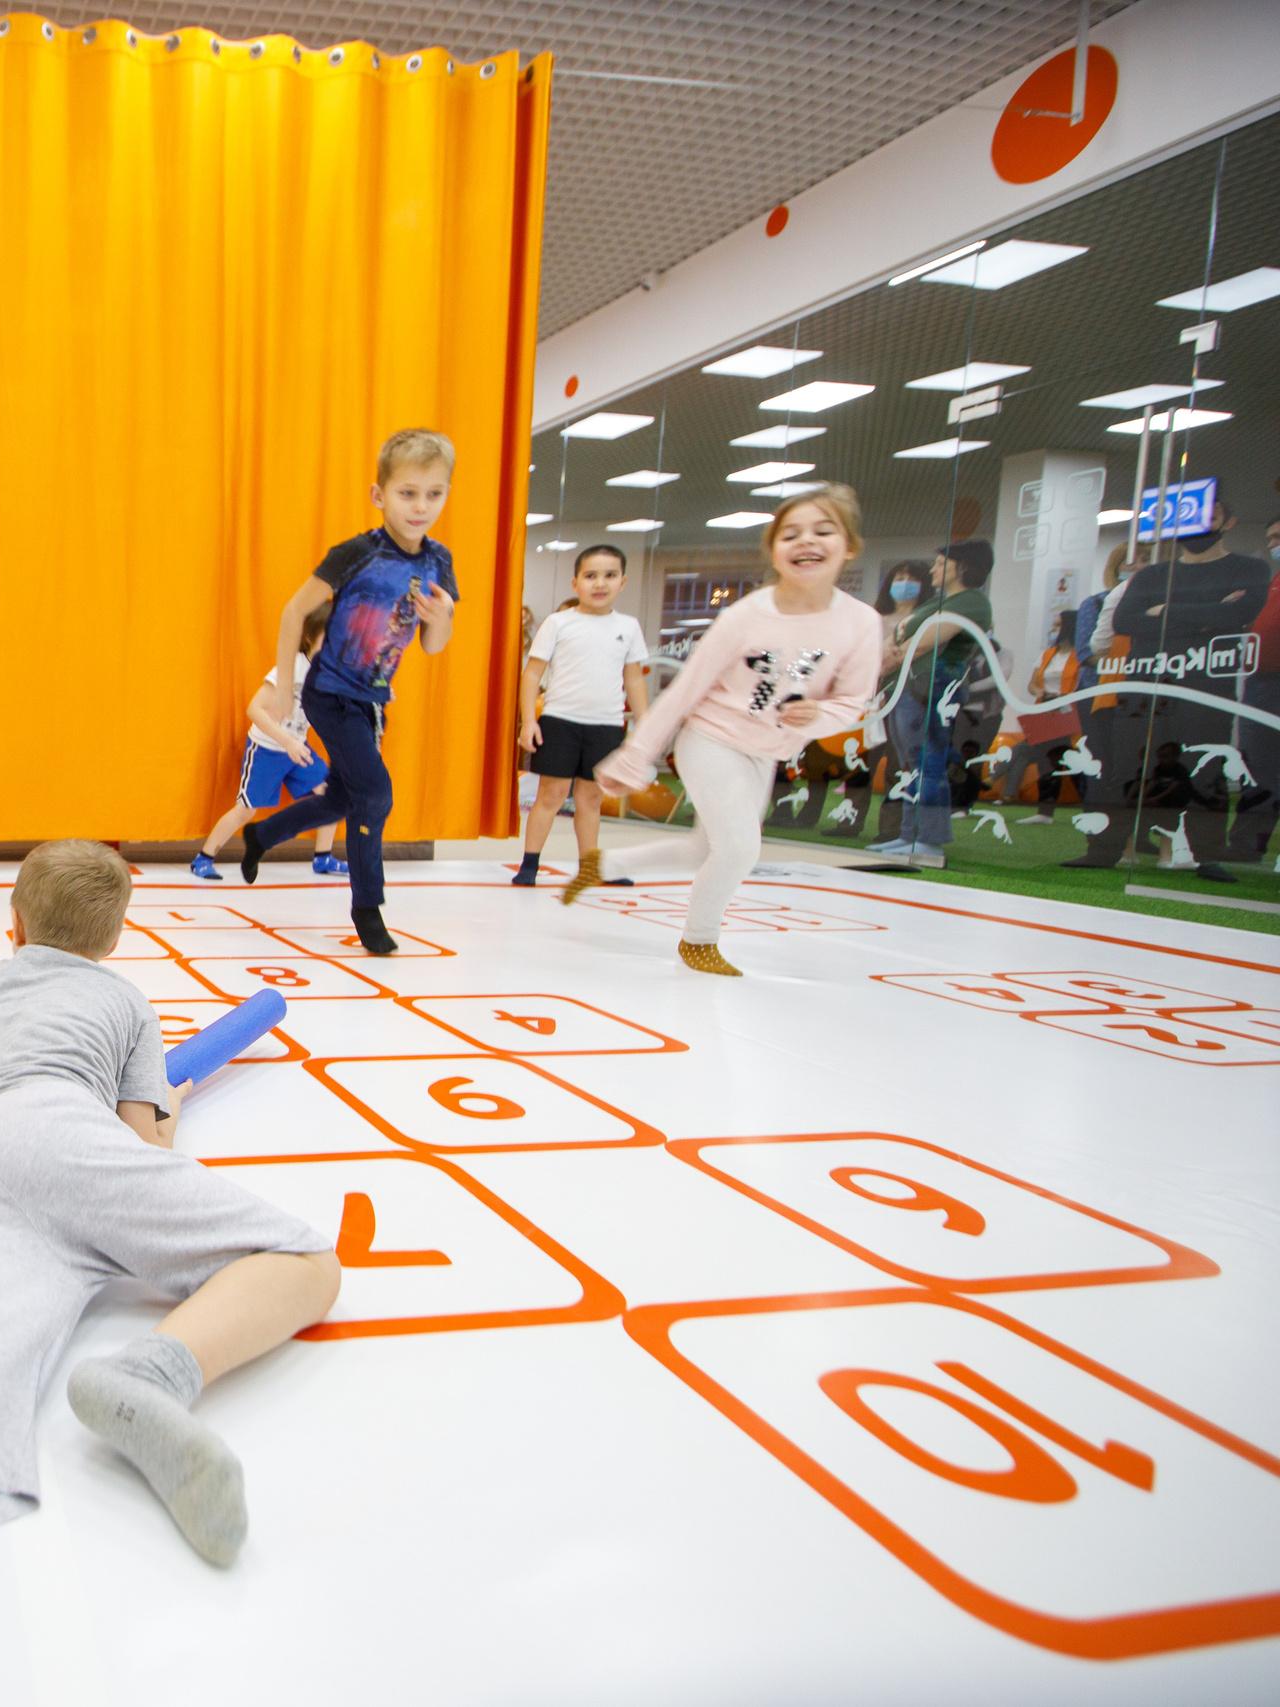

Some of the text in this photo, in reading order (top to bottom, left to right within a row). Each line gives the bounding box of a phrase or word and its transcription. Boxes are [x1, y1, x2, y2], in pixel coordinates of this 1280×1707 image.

[246, 966, 311, 987] 8
[1068, 980, 1166, 999] 3
[493, 1009, 557, 1036] 4
[817, 1360, 1156, 1505] 10
